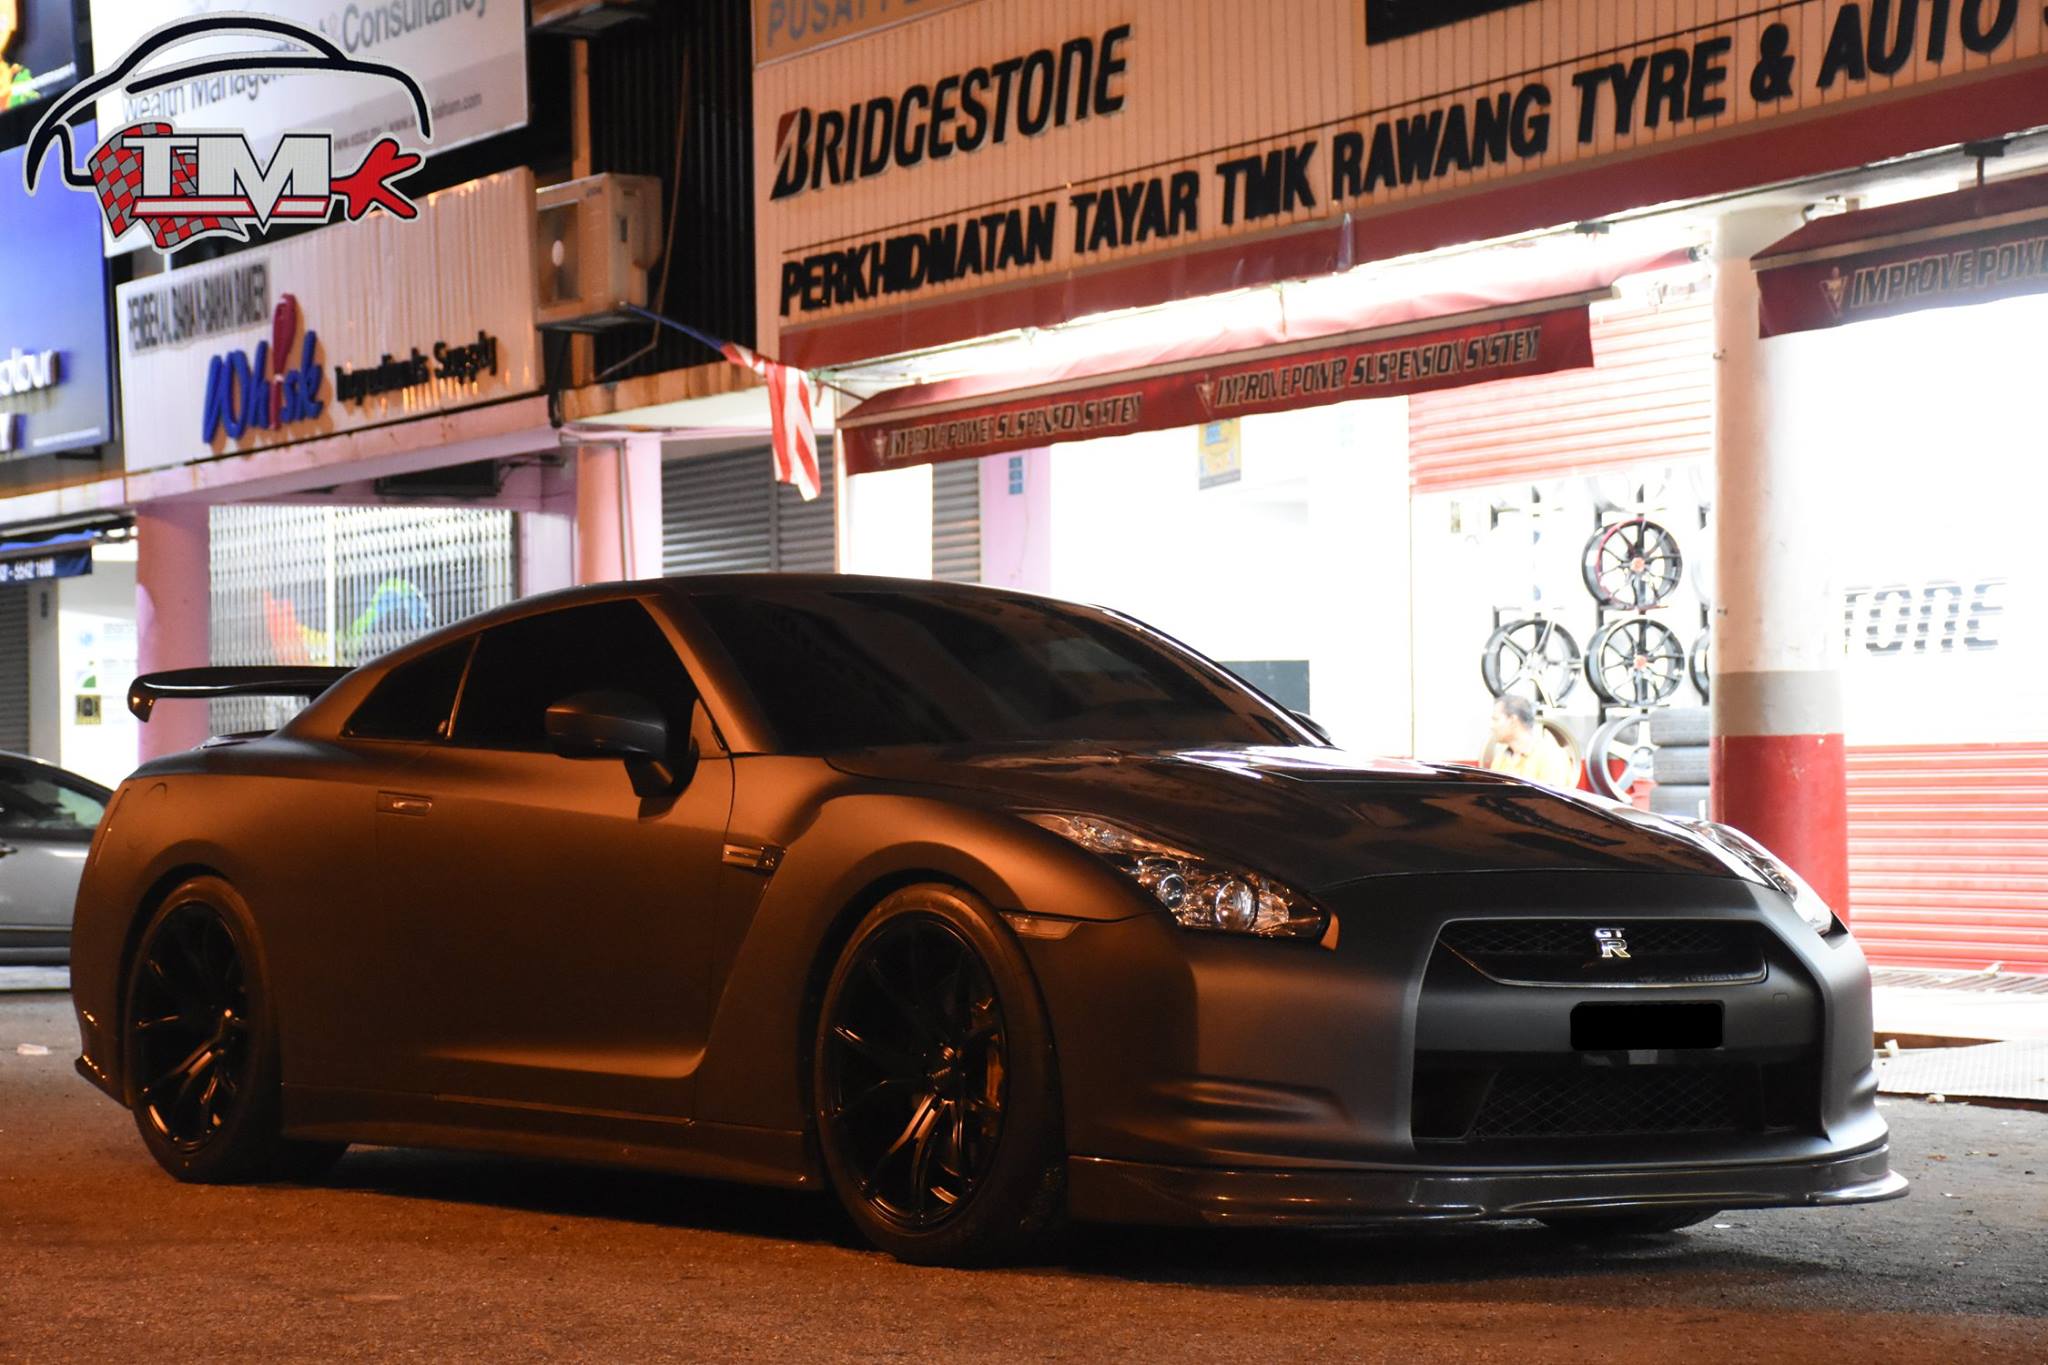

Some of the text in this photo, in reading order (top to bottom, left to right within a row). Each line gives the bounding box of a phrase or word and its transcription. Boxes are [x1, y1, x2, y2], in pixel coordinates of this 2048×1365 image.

[770, 24, 1133, 201] BRIDGESTONE
[779, 0, 2019, 317] PERKHIDMATAN TAYAR TMK RAWANG TYRE & AUTO
[1850, 252, 1973, 308] IMPROVE
[203, 293, 325, 444] Whisk
[1600, 938, 1632, 959] R
